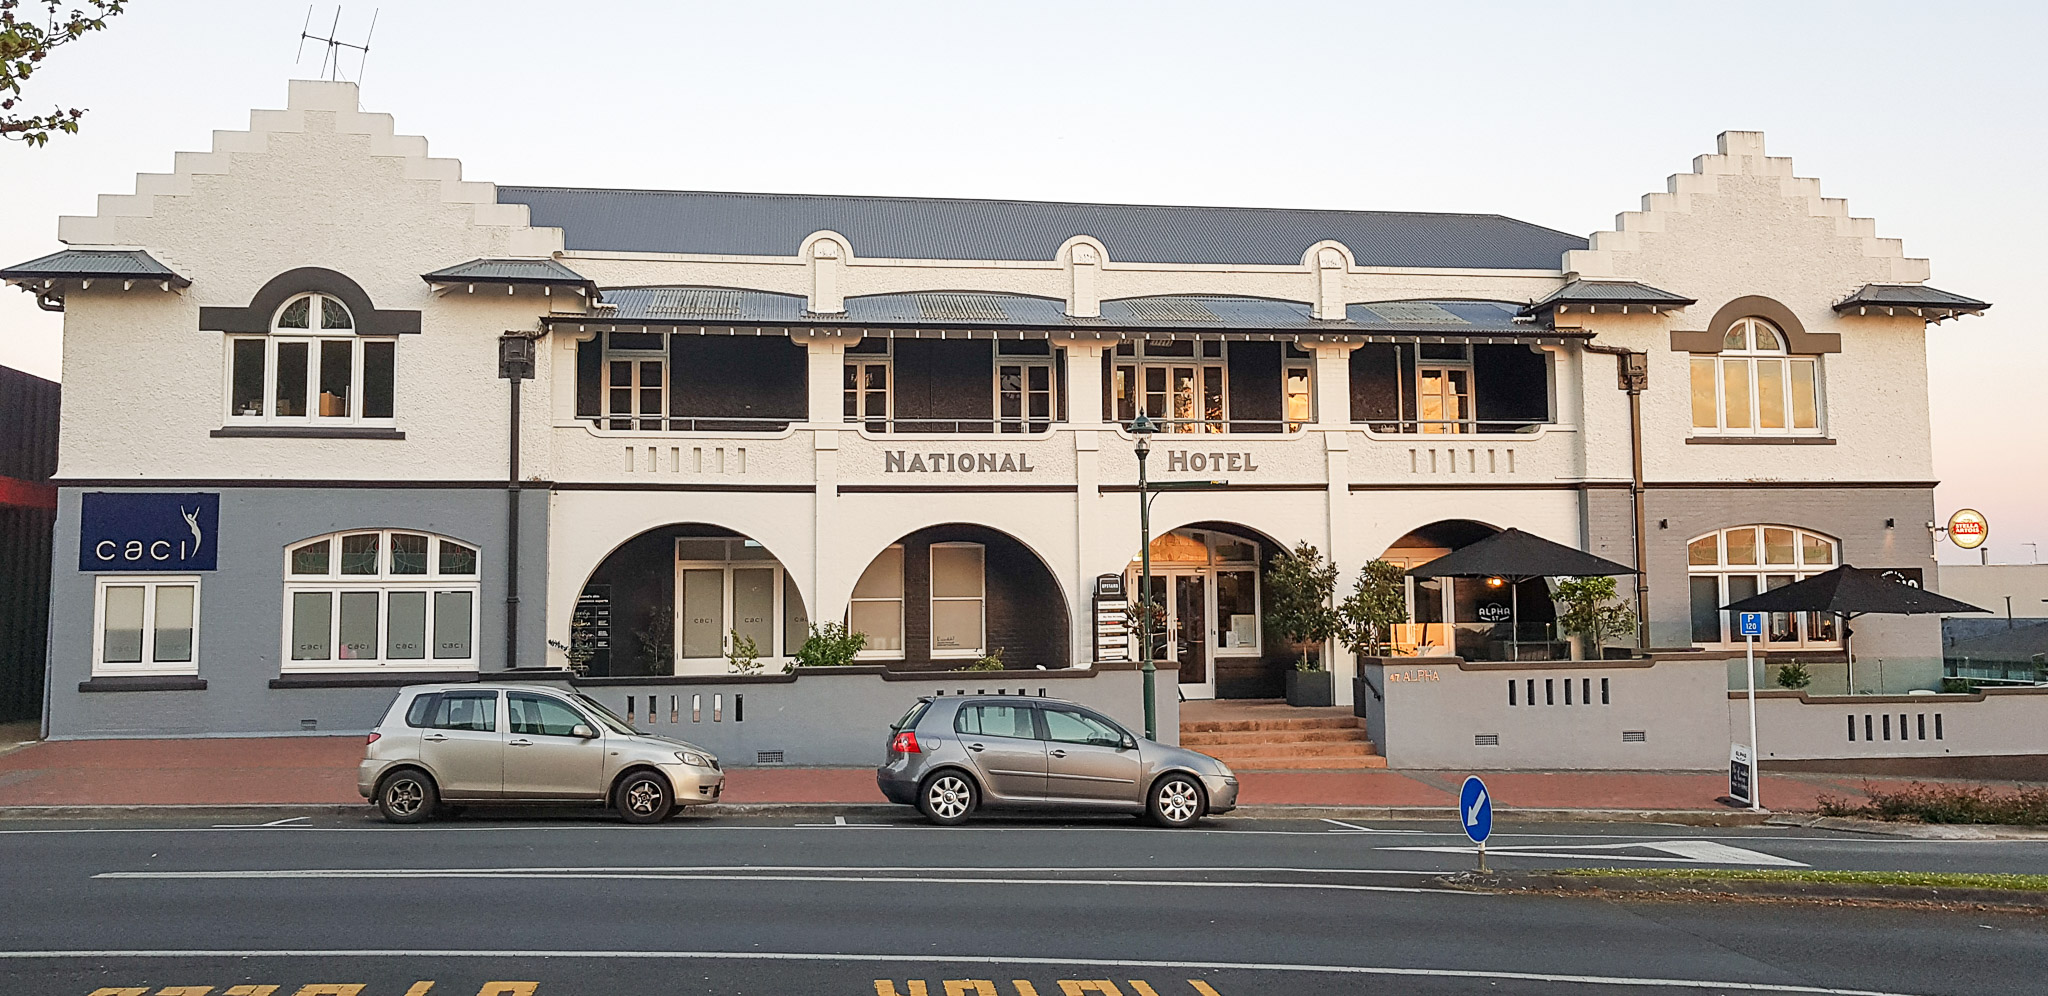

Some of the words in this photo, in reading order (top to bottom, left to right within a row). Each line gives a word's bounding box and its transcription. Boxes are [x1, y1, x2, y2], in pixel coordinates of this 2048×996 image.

[96, 540, 185, 561] caci
[1479, 607, 1511, 616] ALPHA
[1747, 614, 1755, 623] P
[1745, 622, 1757, 630] 120
[1389, 673, 1401, 682] 47
[1402, 669, 1440, 682] ALPHA
